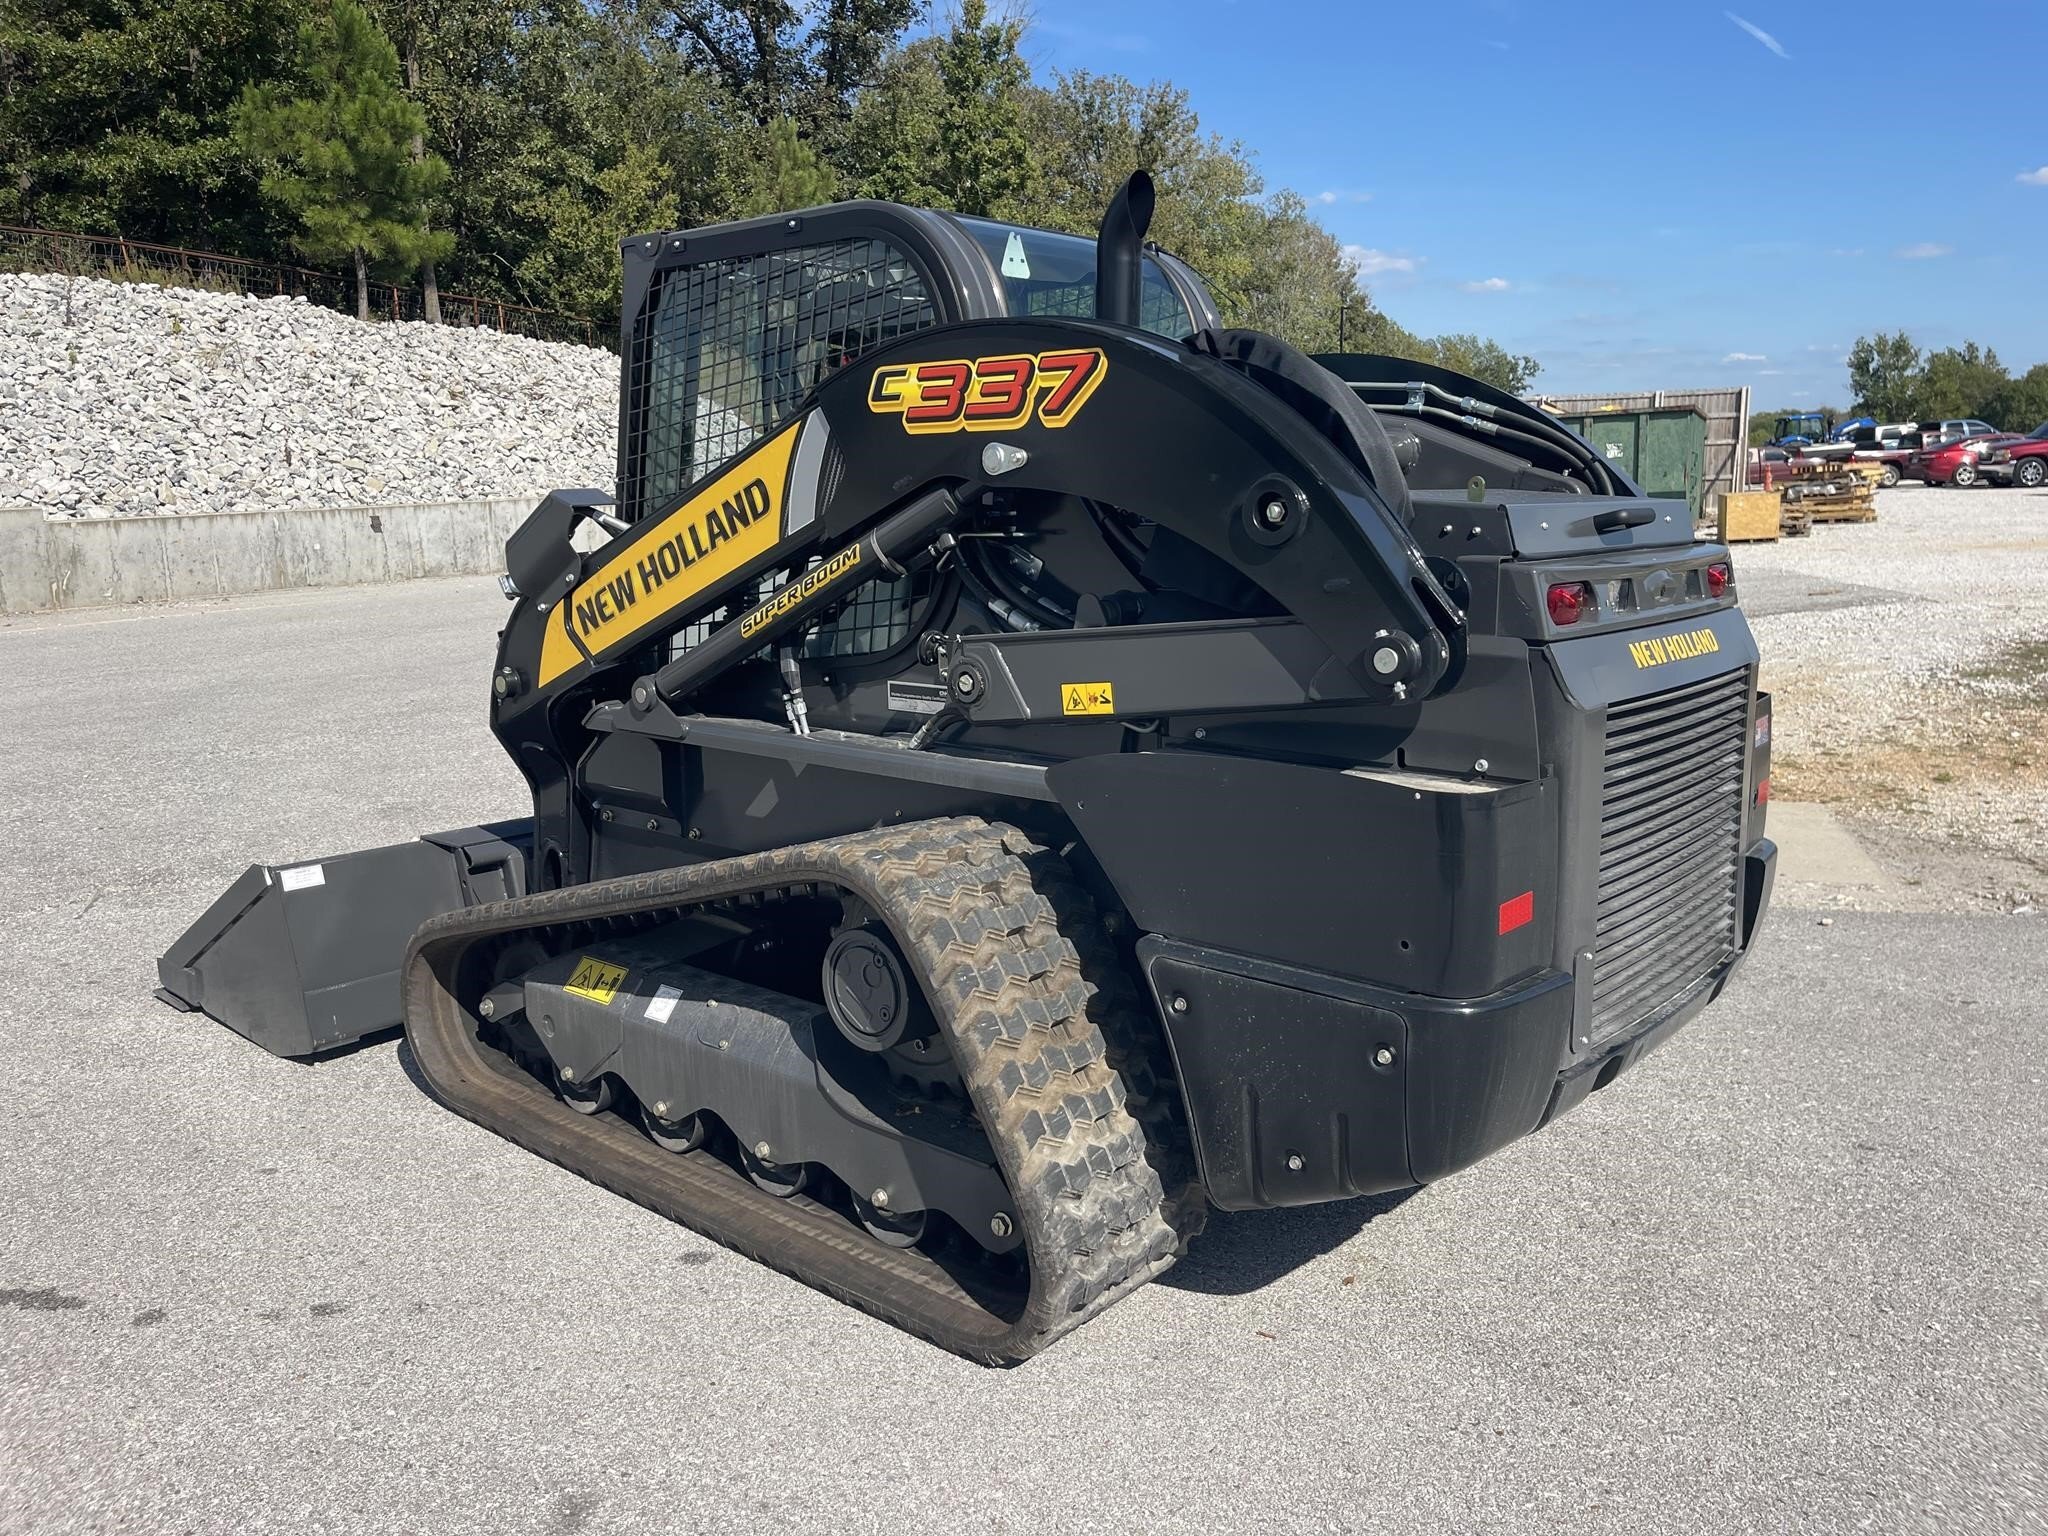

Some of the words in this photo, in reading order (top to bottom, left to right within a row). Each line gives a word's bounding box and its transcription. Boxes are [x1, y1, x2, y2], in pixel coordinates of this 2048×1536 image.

[868, 347, 1108, 435] C337
[576, 568, 636, 636] NEW
[637, 478, 771, 595] HOLLAND
[741, 584, 802, 638] SUPER
[802, 543, 860, 597] BOOM
[1629, 638, 1667, 669] NEW
[1663, 628, 1719, 661] HOLLAND
